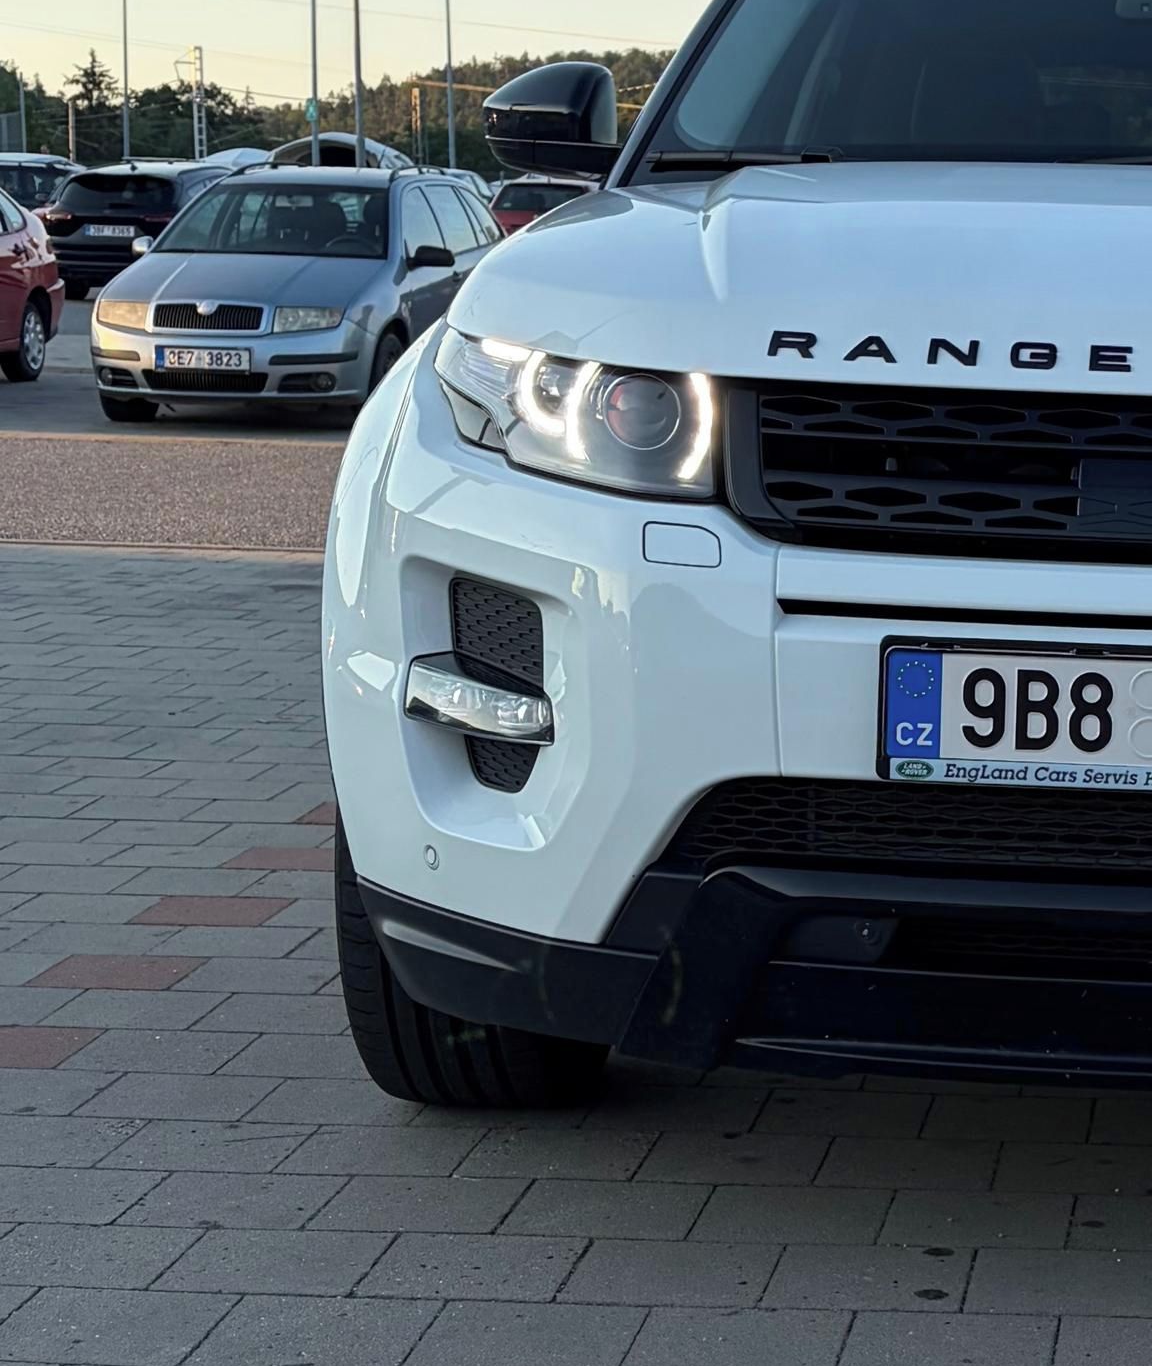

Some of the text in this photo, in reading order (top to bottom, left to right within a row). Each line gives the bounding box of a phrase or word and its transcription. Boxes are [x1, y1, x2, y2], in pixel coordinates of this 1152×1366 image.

[765, 329, 1134, 373] RANGE
[961, 667, 1115, 753] 9B8
[895, 721, 934, 747] CZ
[943, 762, 1028, 783] EngLand
[1034, 766, 1078, 783] Cars
[1082, 768, 1138, 785] Servis
